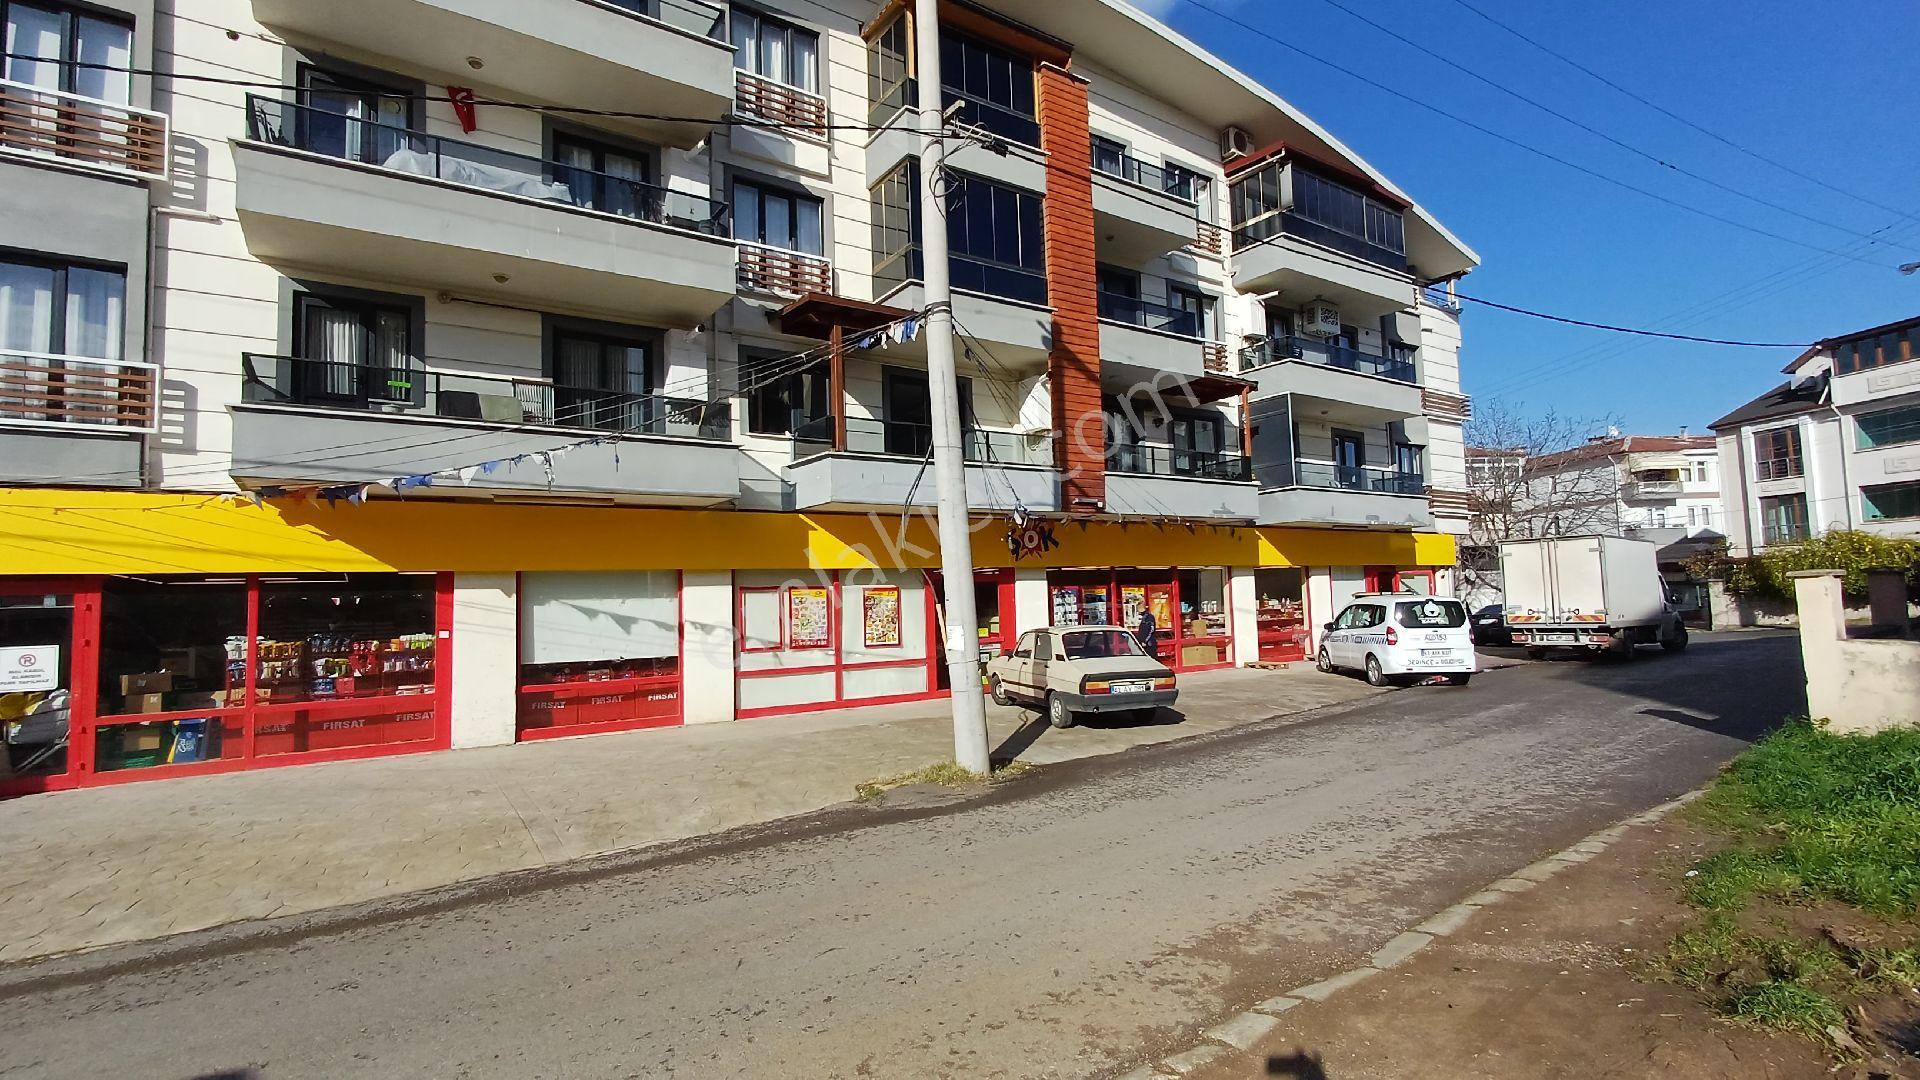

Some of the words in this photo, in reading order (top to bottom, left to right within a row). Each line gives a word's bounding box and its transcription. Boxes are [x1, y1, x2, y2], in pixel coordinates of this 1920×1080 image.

[591, 694, 624, 705] FIRSAT
[647, 691, 678, 702] FIRSAT
[531, 701, 566, 710] FIRSAT
[395, 711, 435, 722] FIRSAT
[322, 719, 366, 731] FIRSAT
